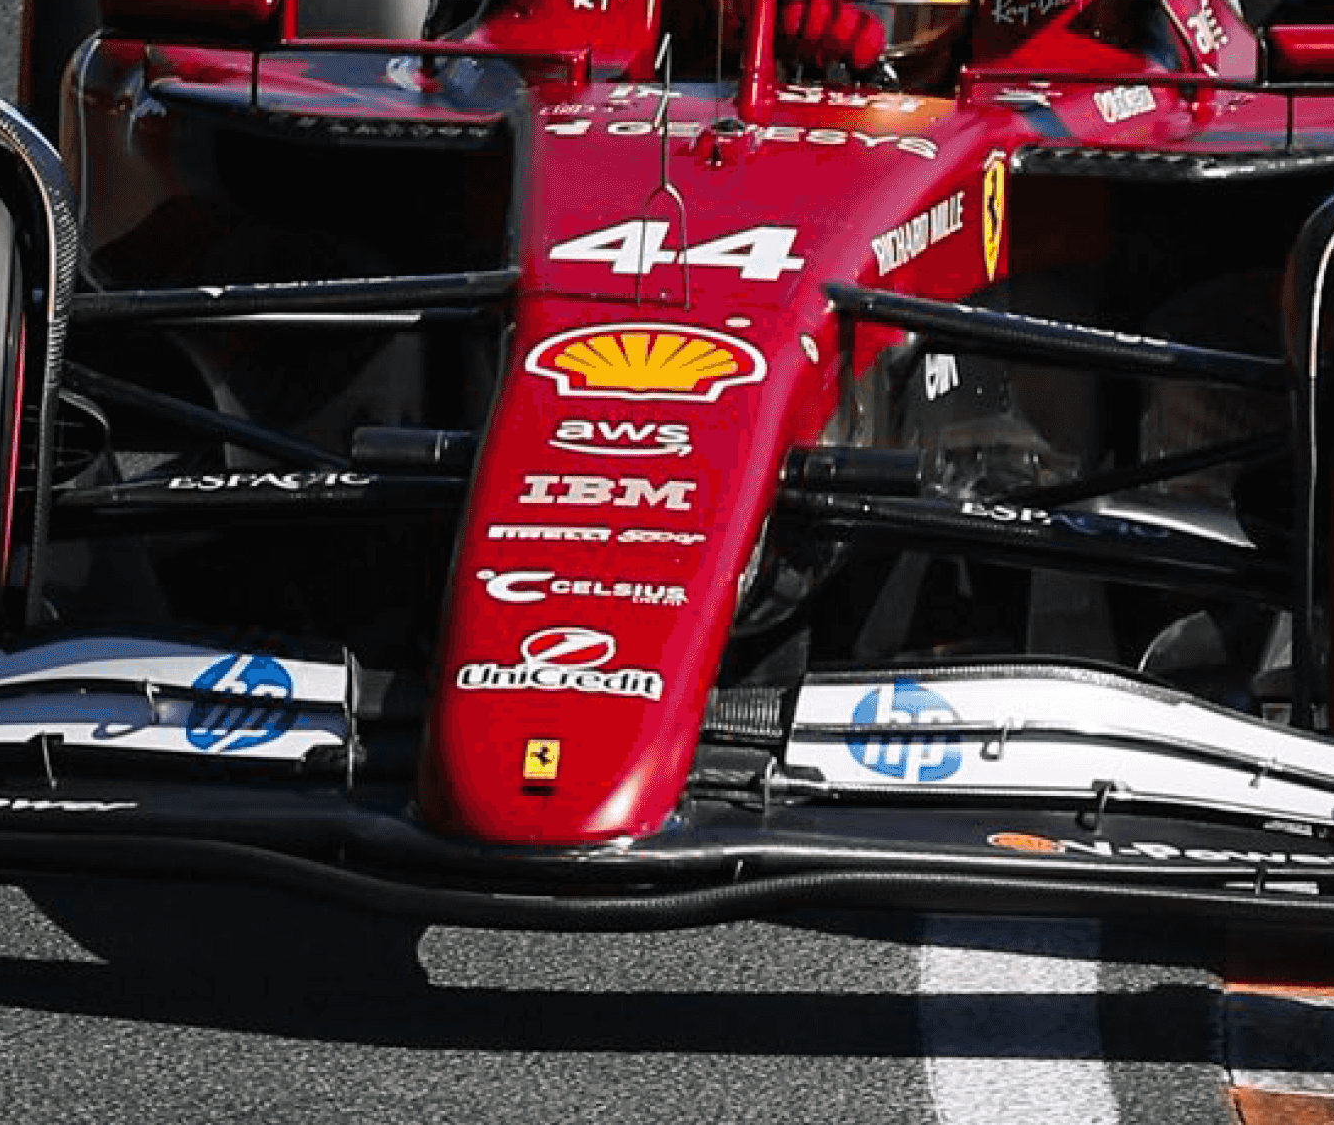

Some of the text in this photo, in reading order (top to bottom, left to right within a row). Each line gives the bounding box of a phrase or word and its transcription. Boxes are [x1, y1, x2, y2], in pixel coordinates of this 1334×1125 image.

[549, 218, 805, 281] 44
[555, 419, 690, 445] aws
[519, 474, 697, 511] IBM
[550, 579, 686, 600] CELSIUS
[459, 665, 656, 697] UniCredit
[857, 678, 957, 781] hp
